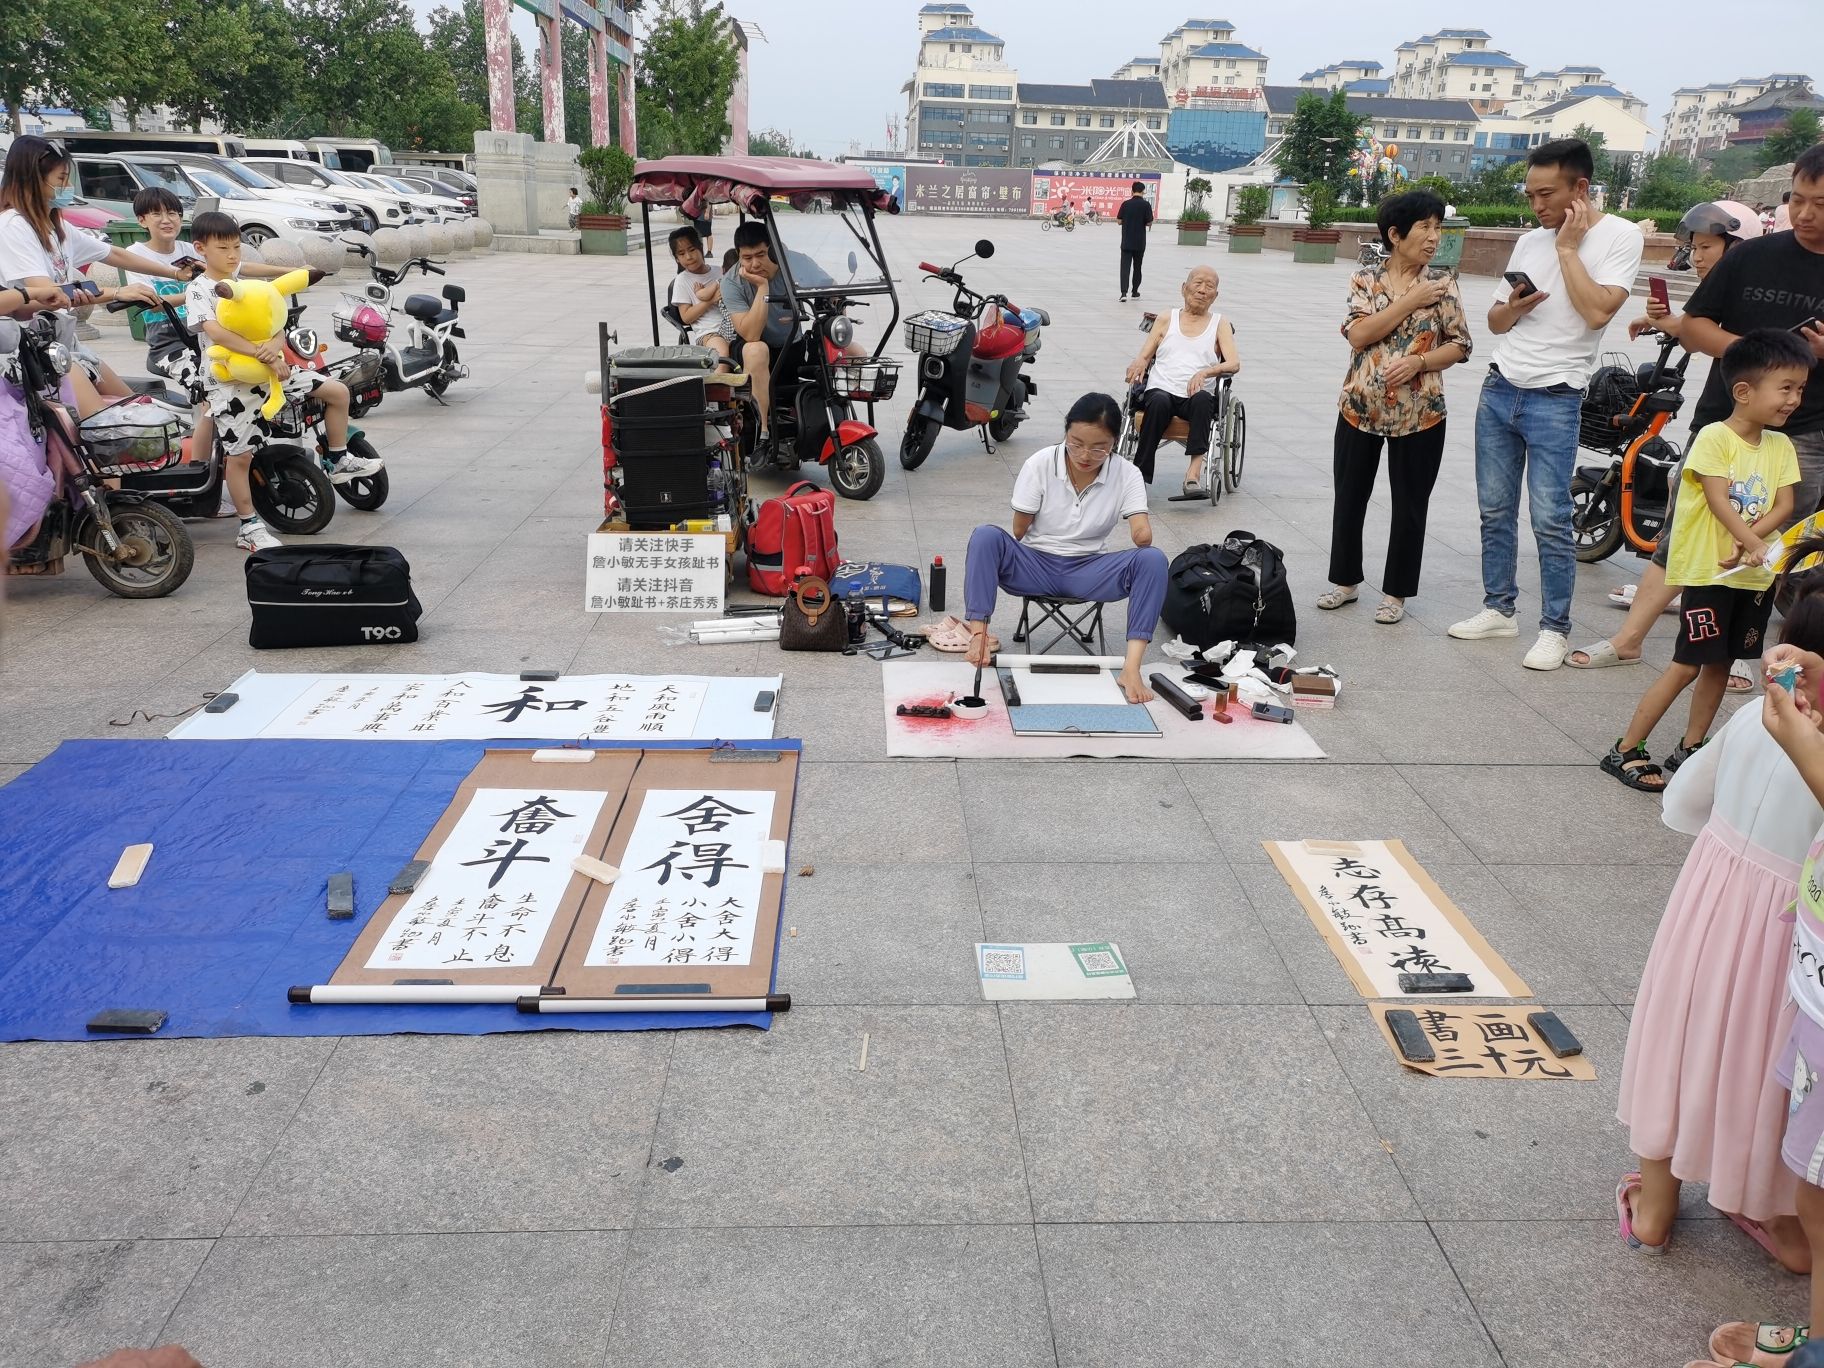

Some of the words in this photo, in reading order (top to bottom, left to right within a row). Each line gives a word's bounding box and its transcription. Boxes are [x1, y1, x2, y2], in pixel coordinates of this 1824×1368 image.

[592, 555, 720, 570] 詹小敏无手女孩趾书
[618, 537, 695, 553] 请关注快手
[590, 595, 719, 610] 詹小敏趾书+茶庄秀秀
[617, 577, 694, 593] 请关注抖音
[360, 625, 402, 640] T90
[1684, 606, 1721, 643] R
[476, 685, 588, 723] 和
[634, 794, 757, 889] 舍得
[484, 892, 539, 964] 生命不息
[661, 896, 708, 964] 小舍小得
[700, 896, 745, 962] 大舍大得
[1433, 1044, 1574, 1077] 三十元
